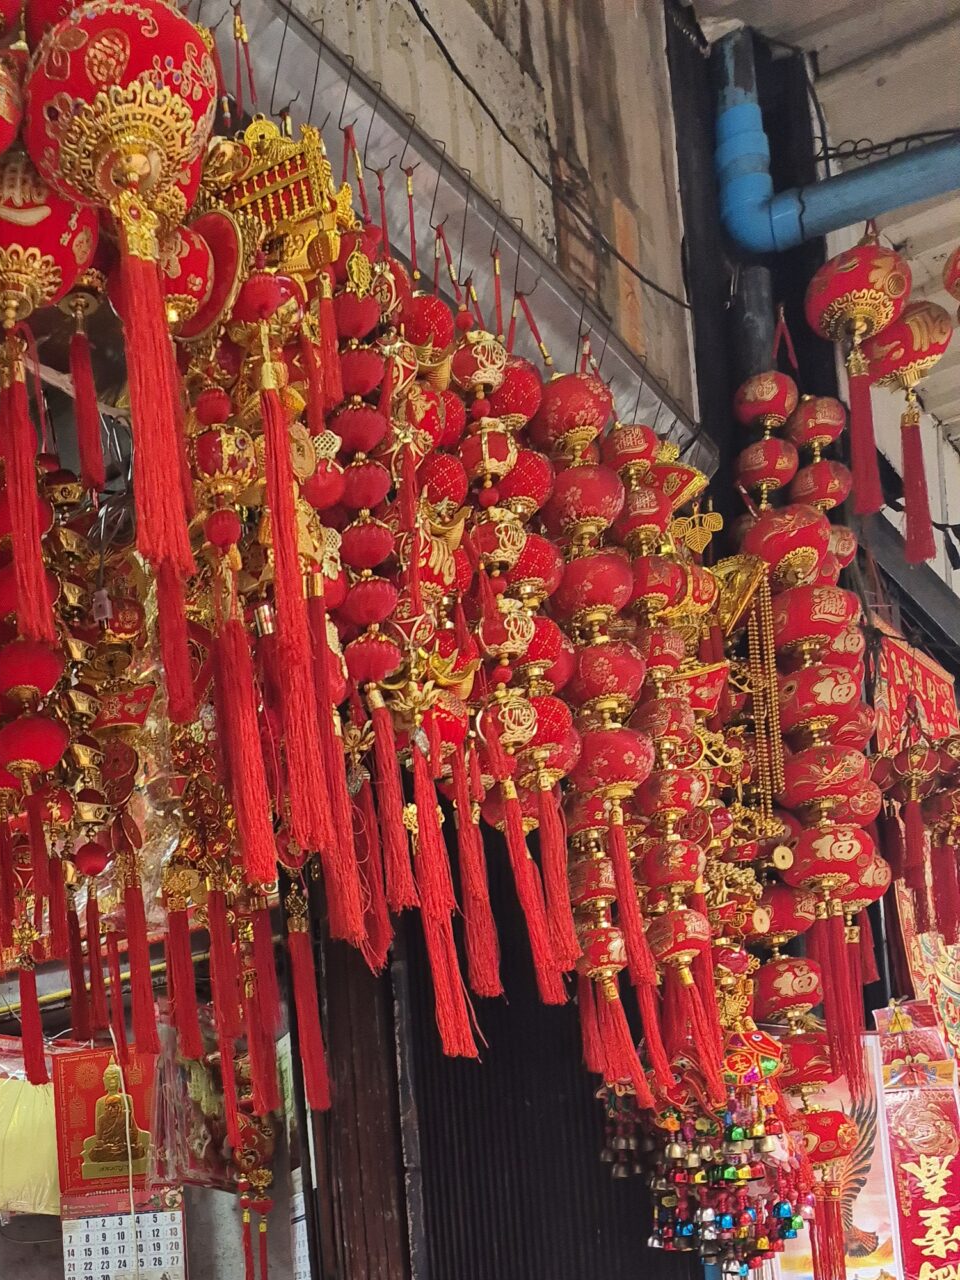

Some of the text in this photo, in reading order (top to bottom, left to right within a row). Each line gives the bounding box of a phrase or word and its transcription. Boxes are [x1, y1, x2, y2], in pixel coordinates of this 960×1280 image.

[812, 669, 856, 705] 福
[812, 830, 861, 861] 福
[773, 960, 819, 997] 福
[86, 1213, 175, 1228] 1 2 3 4 5 6
[69, 1236, 72, 1244] 7
[86, 1234, 89, 1242] 8
[102, 1233, 106, 1241] 9
[117, 1232, 125, 1240] 10
[152, 1229, 160, 1237] 12
[170, 1228, 177, 1236] 13
[68, 1249, 74, 1257] 14
[84, 1248, 92, 1256] 15
[102, 1247, 109, 1255] 16
[118, 1246, 125, 1254] 17
[153, 1243, 160, 1251] 19
[170, 1242, 179, 1250] 20
[68, 1263, 75, 1271] 21
[84, 1262, 92, 1270] 22
[101, 1261, 109, 1269] 23
[118, 1260, 126, 1268] 24
[153, 1258, 162, 1266] 26
[171, 1257, 179, 1265] 27
